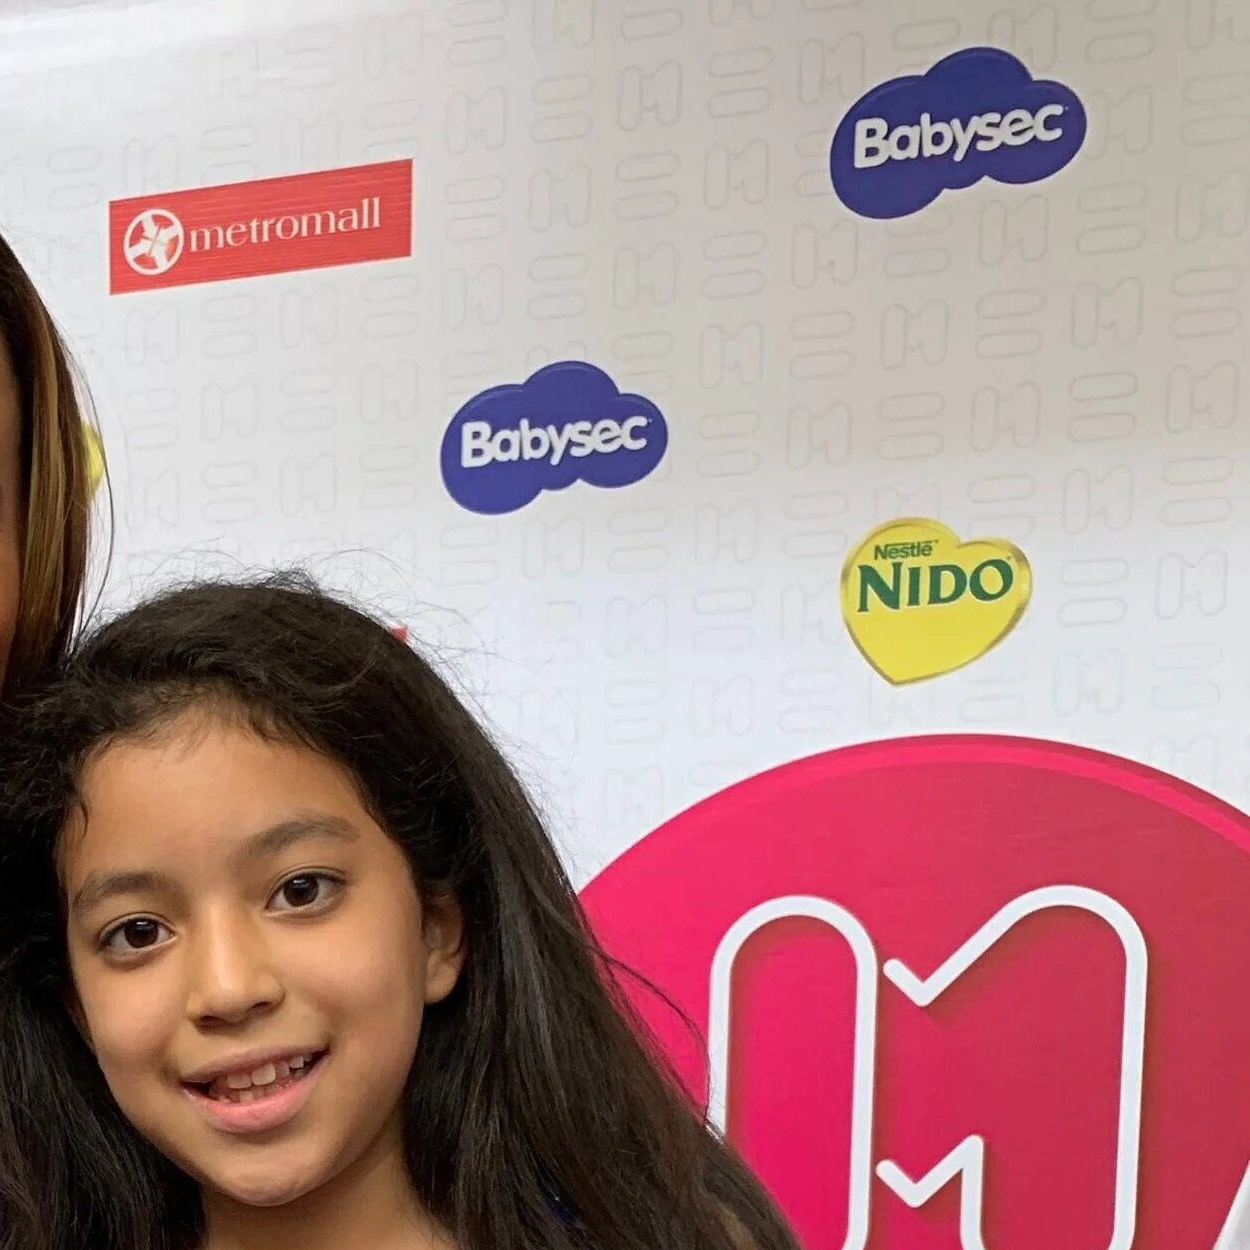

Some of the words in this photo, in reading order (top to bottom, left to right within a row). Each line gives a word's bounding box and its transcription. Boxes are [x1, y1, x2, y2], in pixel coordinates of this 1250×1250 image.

[853, 104, 1064, 169] Babysec
[189, 196, 381, 252] metromall
[461, 415, 648, 468] Babysec
[857, 558, 1014, 613] NIDO
